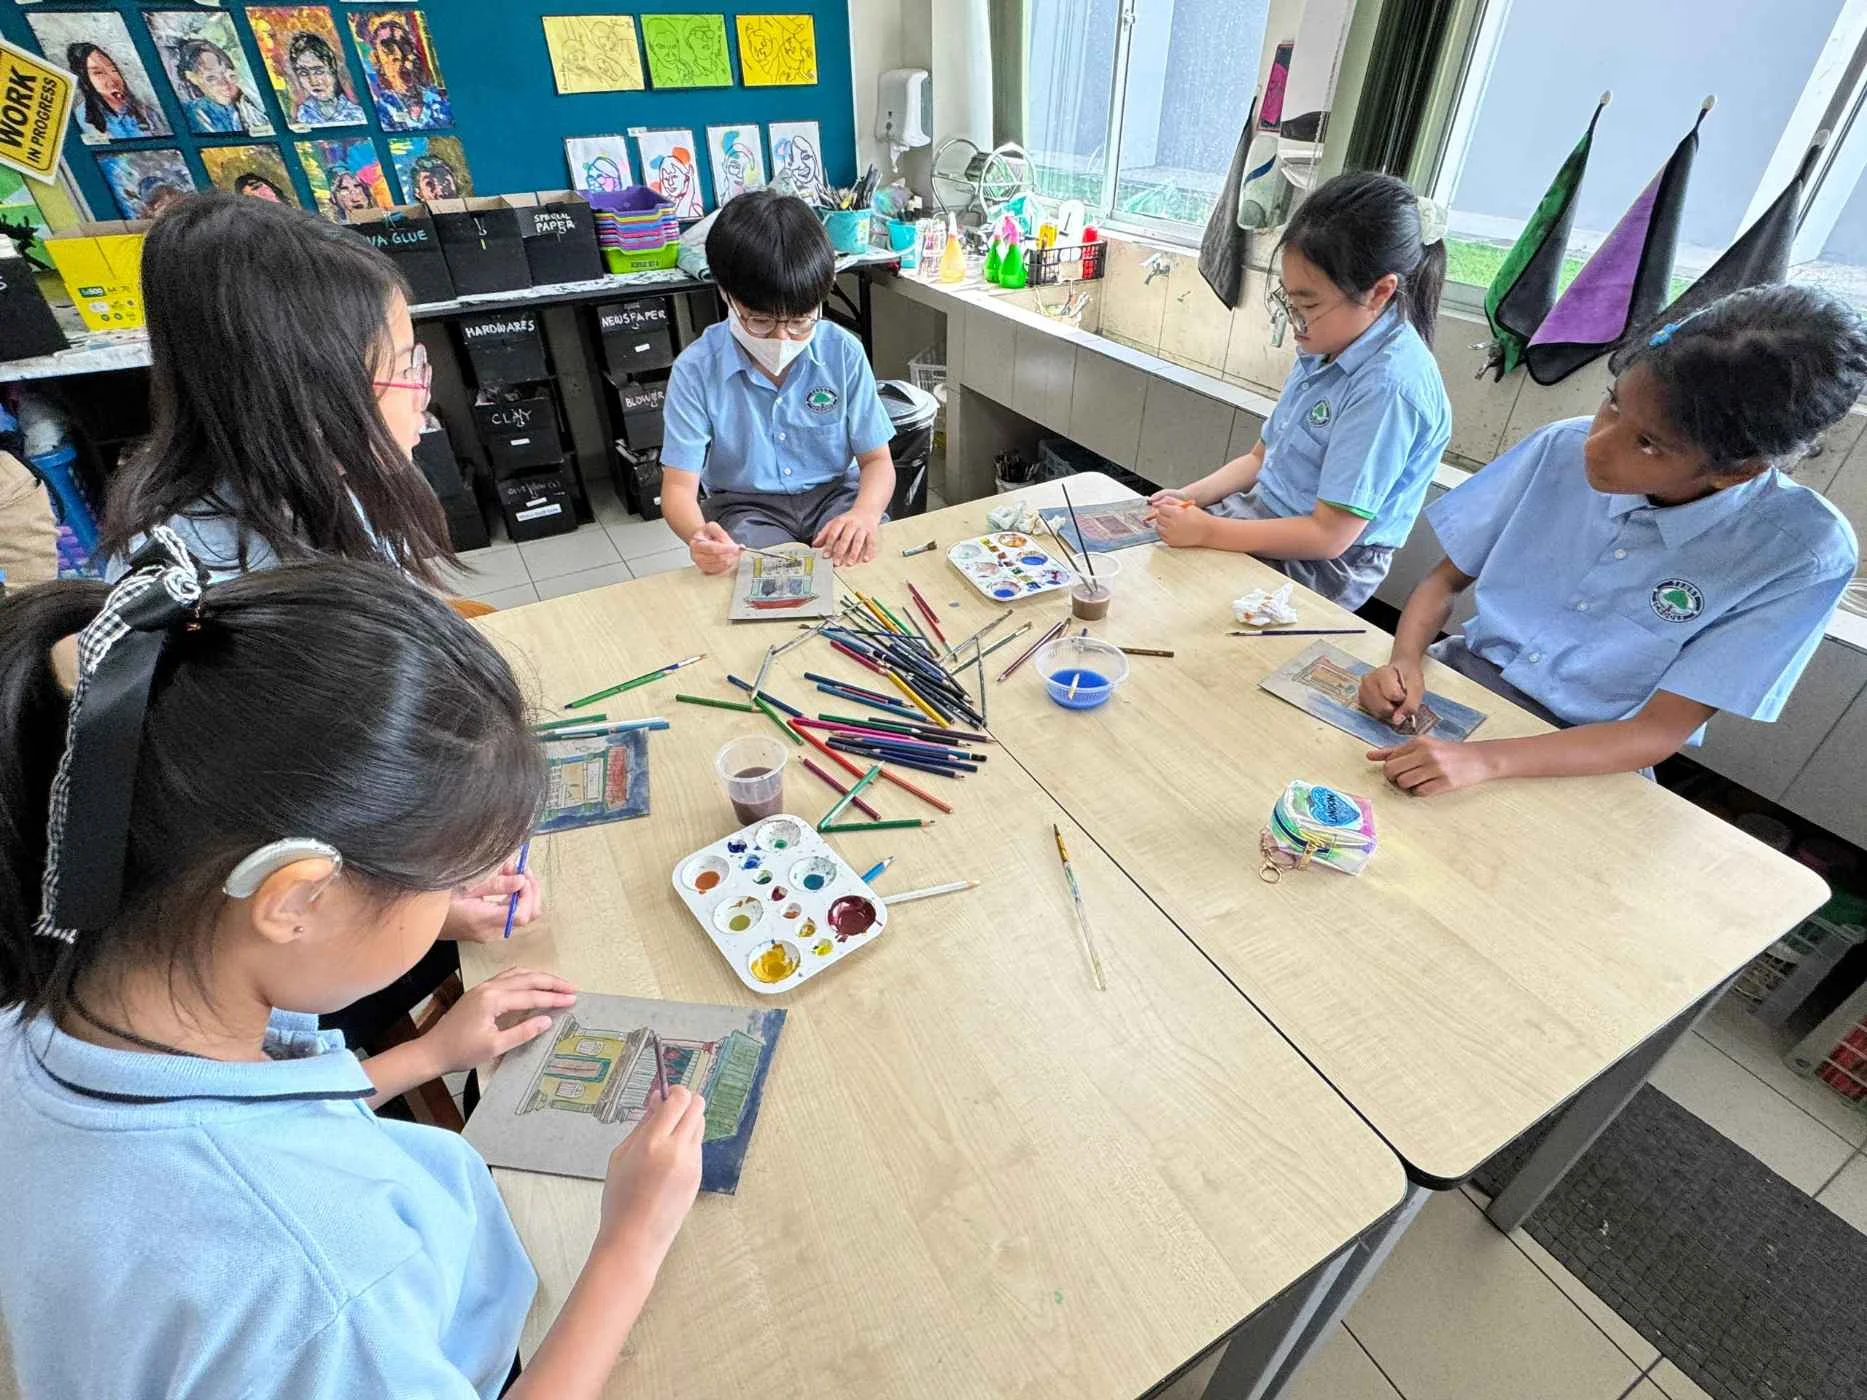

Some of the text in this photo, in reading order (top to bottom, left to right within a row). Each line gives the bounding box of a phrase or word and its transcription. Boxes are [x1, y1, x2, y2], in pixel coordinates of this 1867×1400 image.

[0, 64, 37, 148] WORK
[26, 77, 58, 163] IN PROGRESS
[536, 220, 576, 233] PAPER
[392, 229, 428, 244] GLUE
[465, 320, 535, 338] HARDWARES
[491, 408, 533, 426] CLAY
